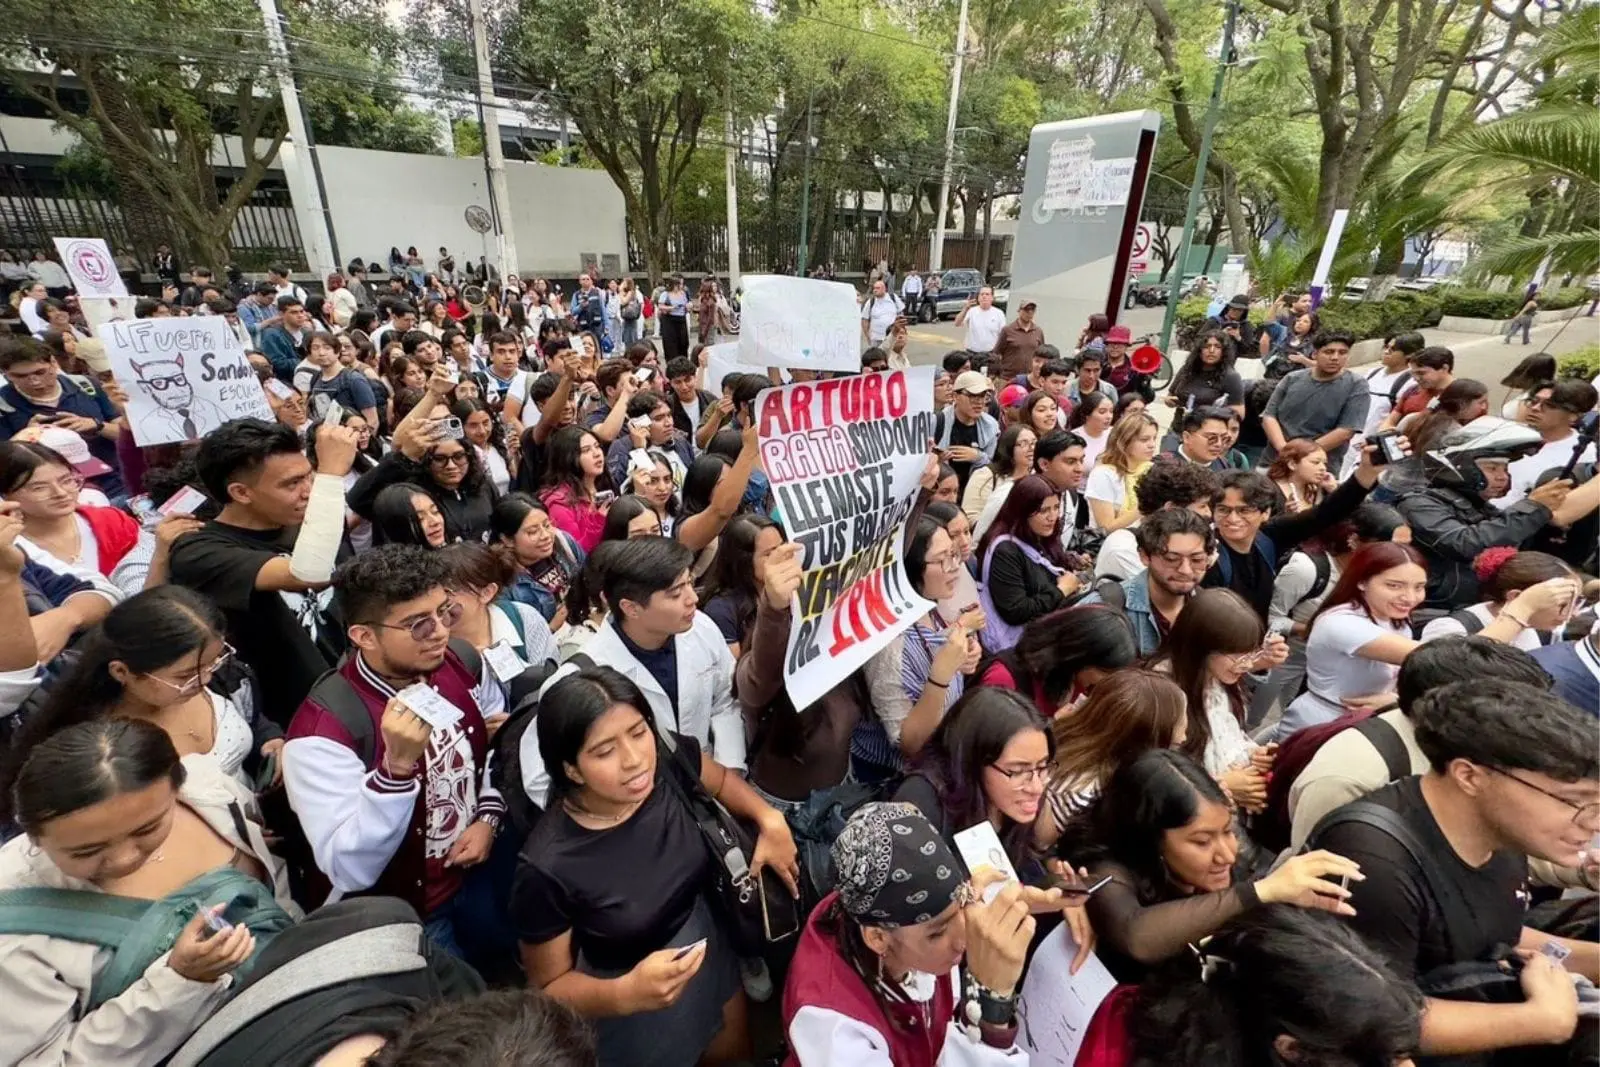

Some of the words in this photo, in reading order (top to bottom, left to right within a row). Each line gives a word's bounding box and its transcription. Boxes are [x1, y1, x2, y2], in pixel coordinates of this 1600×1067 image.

[759, 370, 908, 438] ARTURO
[761, 425, 856, 484] RATA
[778, 462, 895, 534] LLENASTE
[794, 519, 847, 571] TUS
[788, 614, 821, 676] AL
